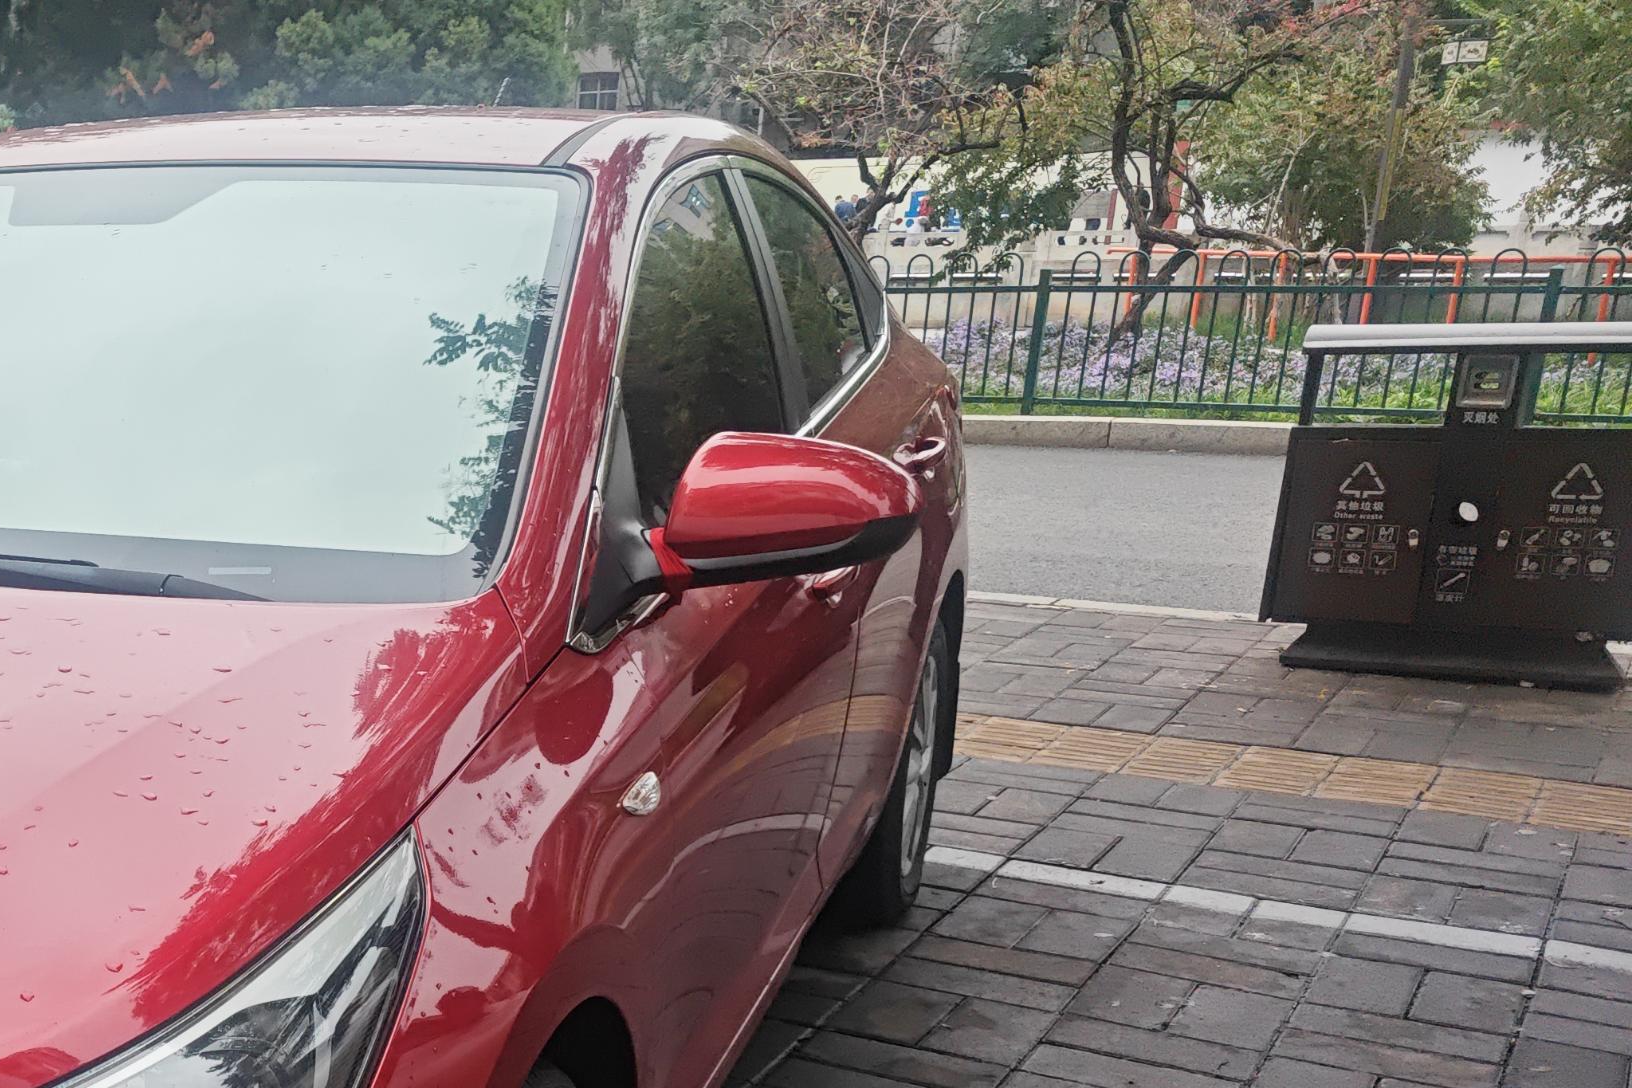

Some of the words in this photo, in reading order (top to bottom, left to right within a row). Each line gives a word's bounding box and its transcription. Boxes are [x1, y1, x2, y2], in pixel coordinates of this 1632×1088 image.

[1462, 411, 1499, 424] 灭烟处
[1335, 500, 1384, 512] 其他垃圾
[1334, 511, 1356, 519] Other
